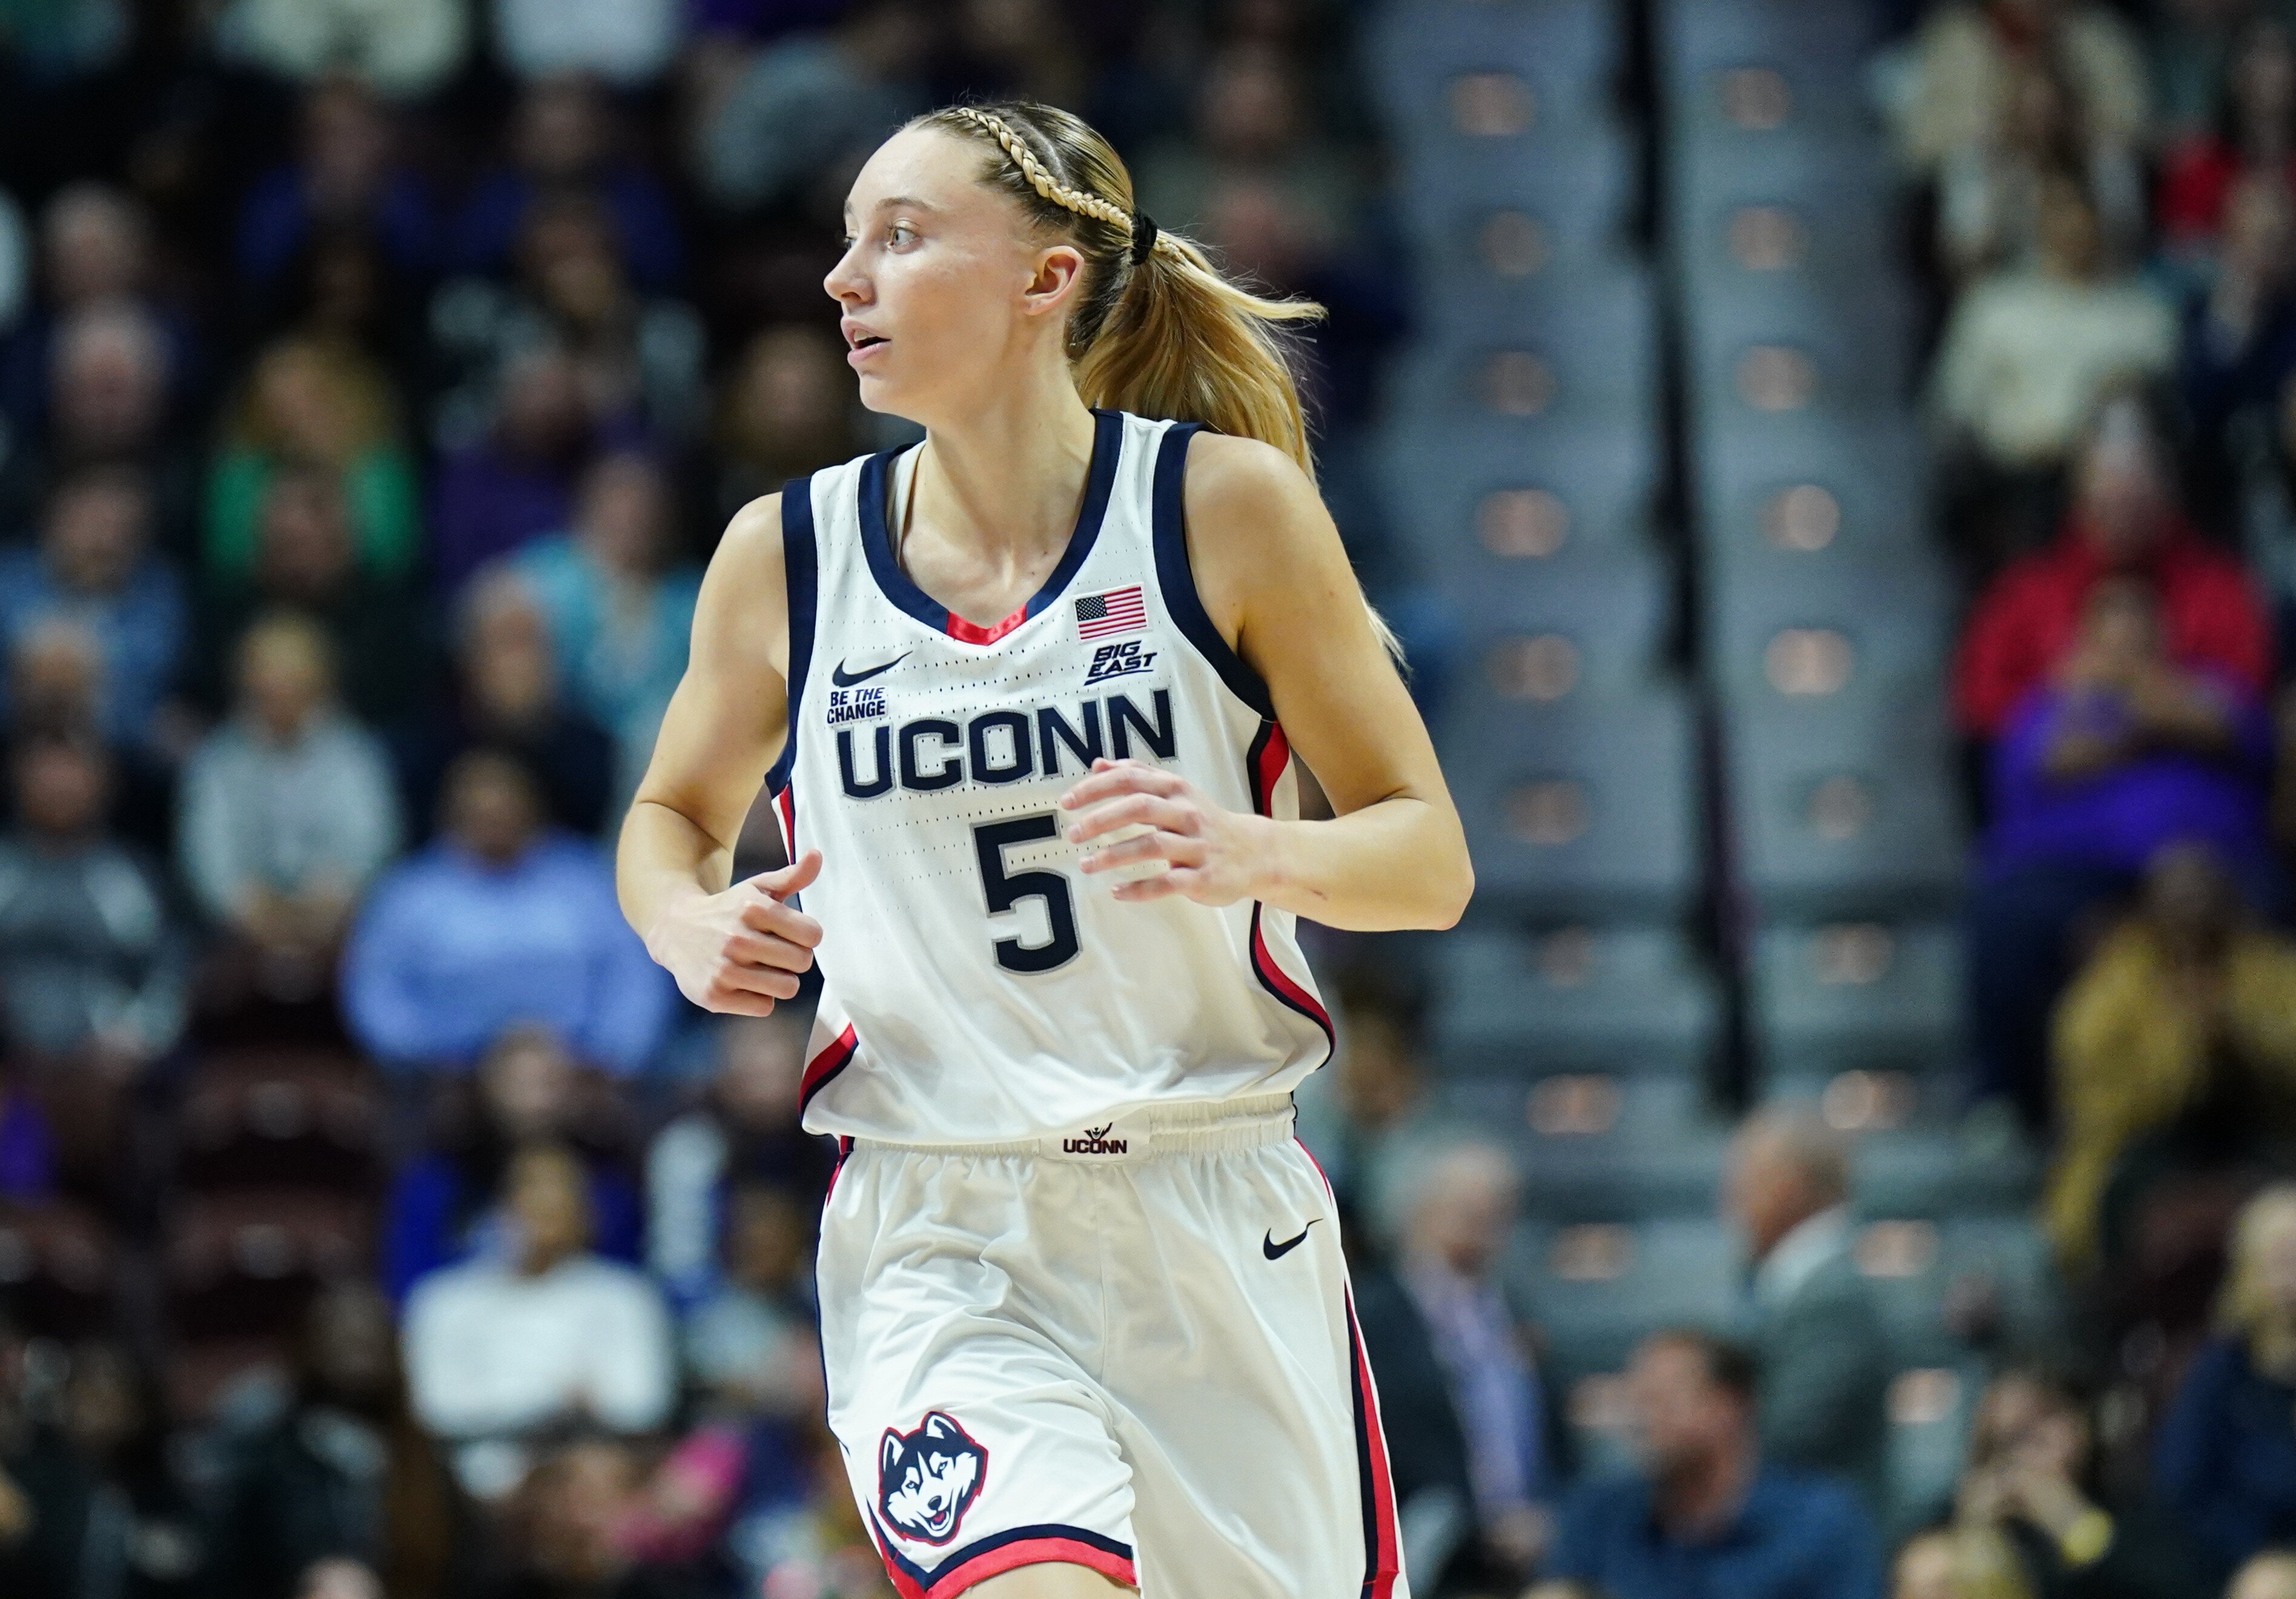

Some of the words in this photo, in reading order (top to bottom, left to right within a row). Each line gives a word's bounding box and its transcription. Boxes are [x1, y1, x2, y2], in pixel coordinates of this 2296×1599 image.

[1093, 640, 1142, 663] BIG
[1087, 652, 1157, 678] EAST
[830, 690, 849, 707] BE
[855, 687, 885, 703] THE
[827, 700, 885, 724] CHANGE
[836, 688, 1179, 801] UCONN
[970, 810, 1083, 976] 5
[1063, 1138, 1127, 1154] UCONN
